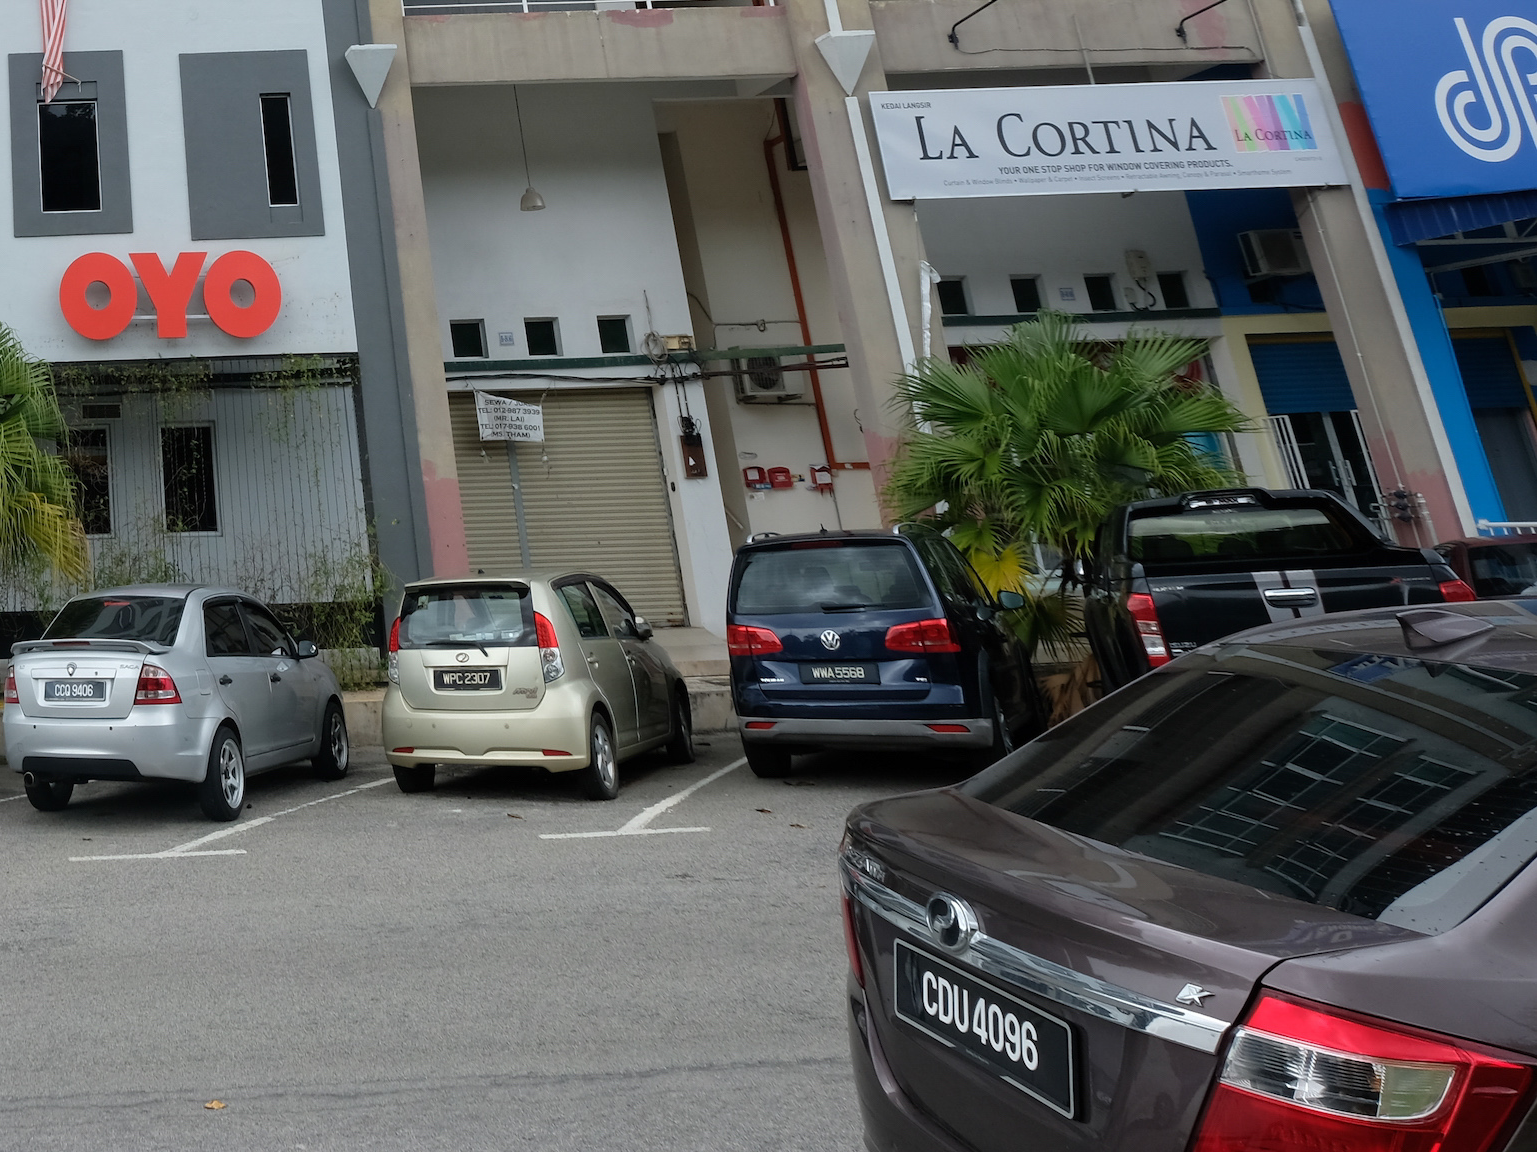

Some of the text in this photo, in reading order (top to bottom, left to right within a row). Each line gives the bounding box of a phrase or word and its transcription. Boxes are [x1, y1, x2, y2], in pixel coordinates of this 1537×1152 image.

[915, 113, 1218, 160] LA CORTINA
[998, 159, 1233, 175] YOUR ONE STOP SHOP FOR WINDOW COVERING PRODUCTS.
[59, 250, 282, 340] OYO
[443, 672, 491, 684] WPC 2307
[54, 684, 93, 697] CCQ 9406
